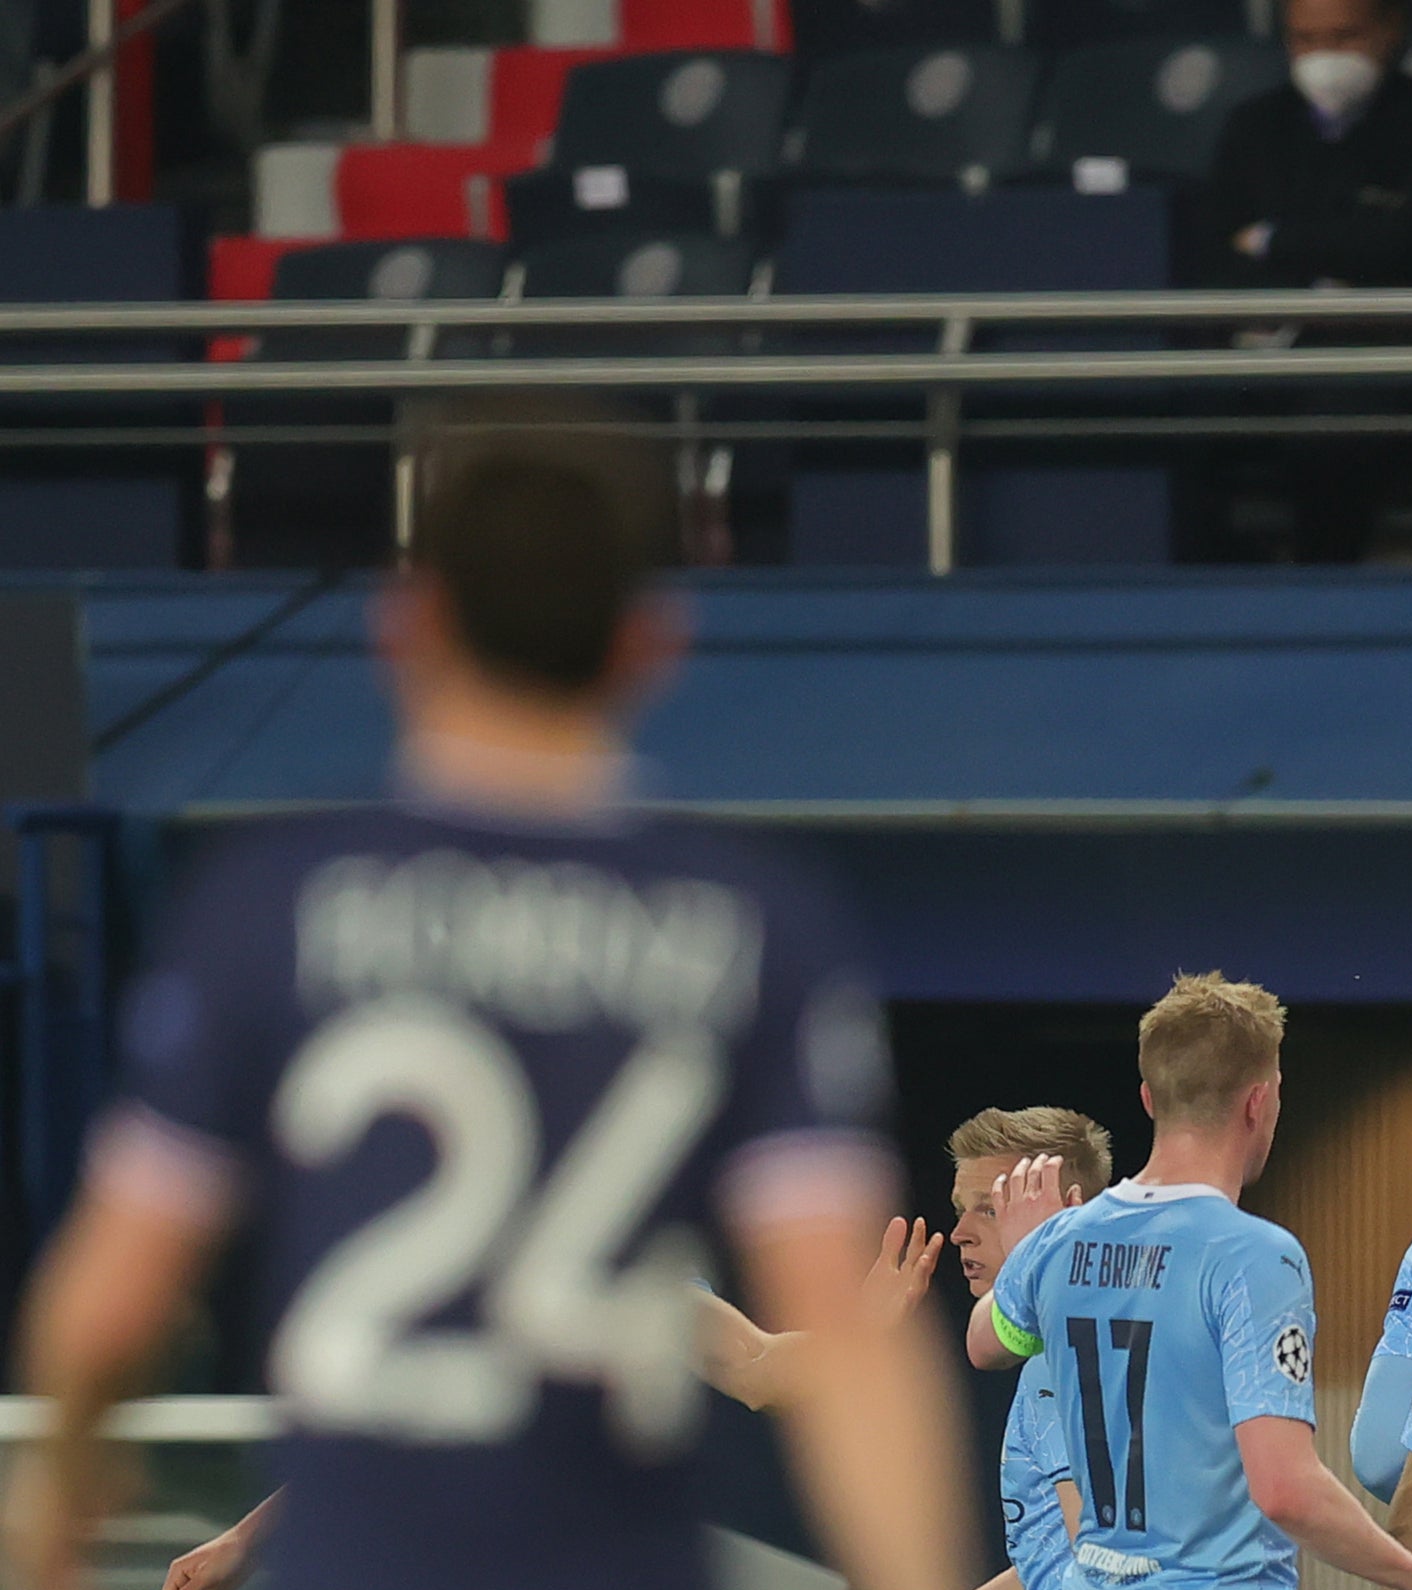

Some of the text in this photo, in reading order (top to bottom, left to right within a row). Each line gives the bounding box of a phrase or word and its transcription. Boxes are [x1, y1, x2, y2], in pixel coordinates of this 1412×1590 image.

[270, 992, 730, 1465] 24
[1068, 1240, 1098, 1287] DE
[1066, 1316, 1154, 1533] 17
